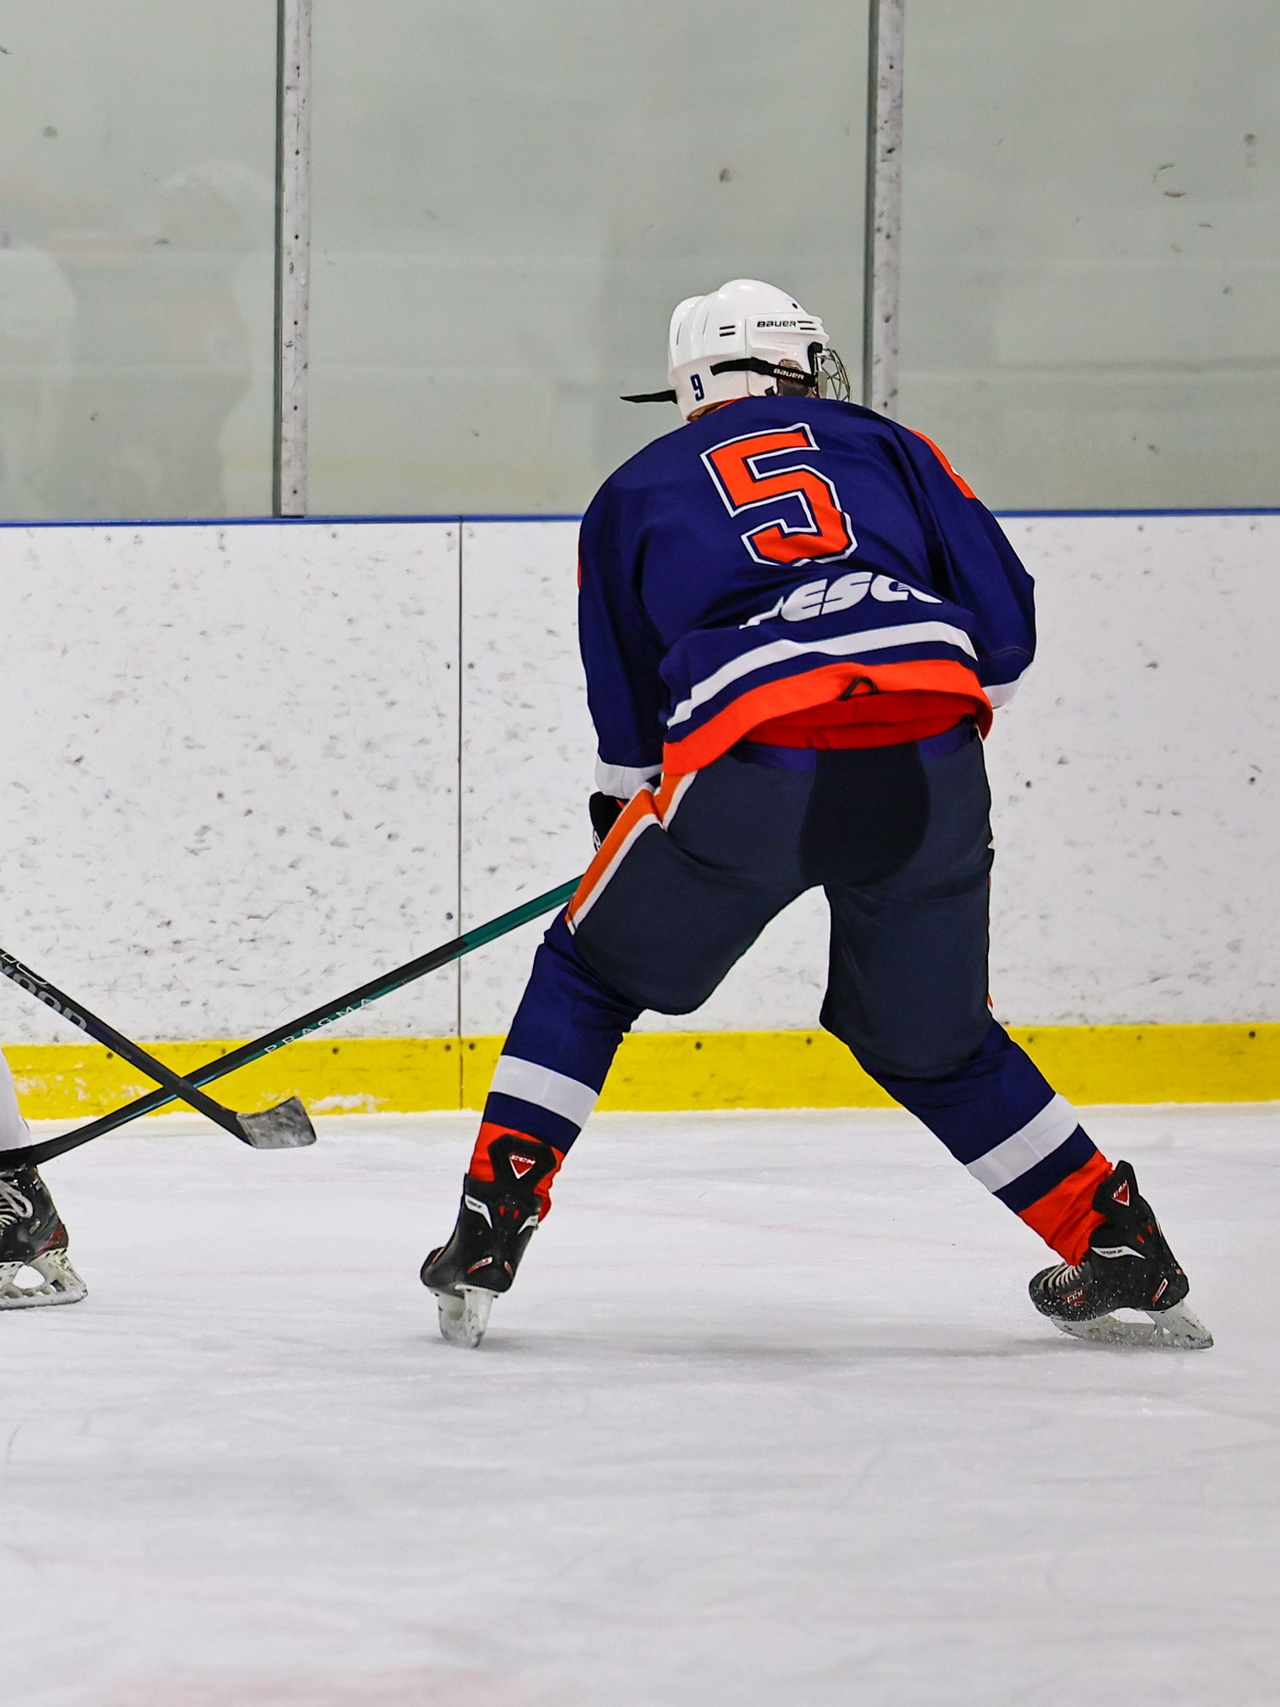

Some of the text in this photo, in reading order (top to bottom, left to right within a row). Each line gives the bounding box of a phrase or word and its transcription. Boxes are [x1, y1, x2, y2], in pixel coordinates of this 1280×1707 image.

[757, 319, 797, 328] BAUER
[690, 373, 705, 401] 9
[773, 368, 805, 381] BAUER
[700, 422, 858, 567] 5
[264, 998, 372, 1053] PRAGMA
